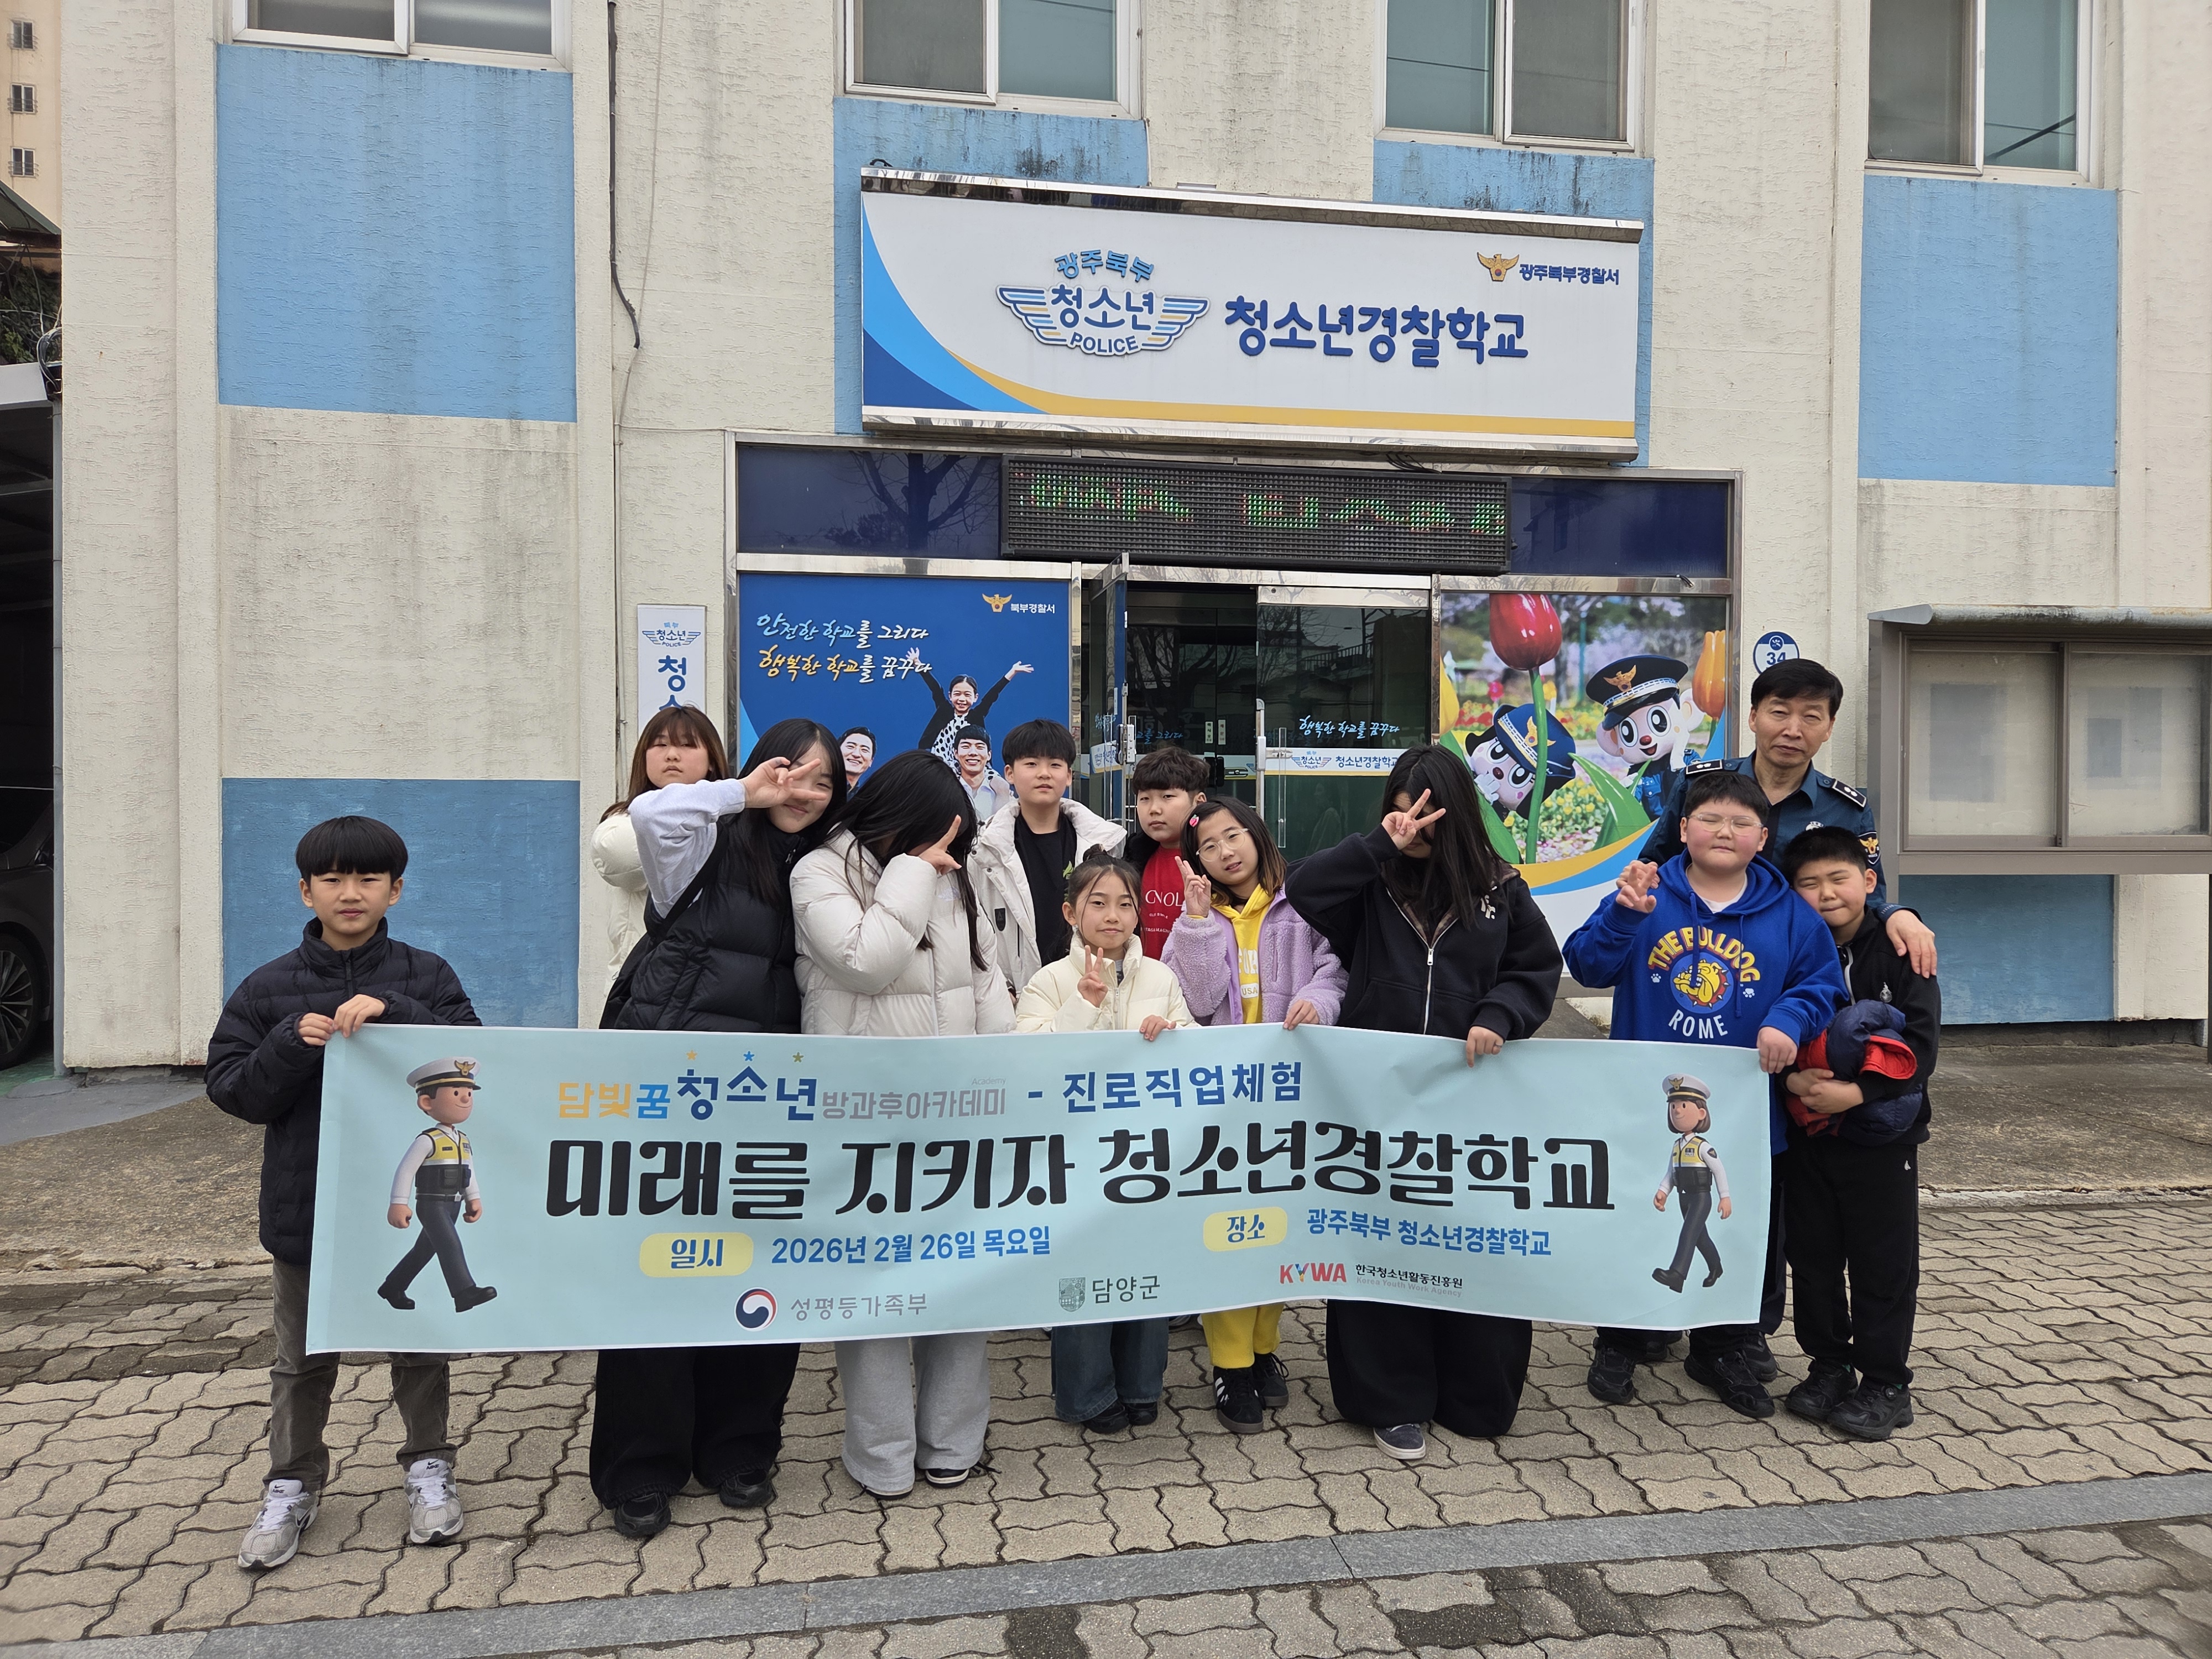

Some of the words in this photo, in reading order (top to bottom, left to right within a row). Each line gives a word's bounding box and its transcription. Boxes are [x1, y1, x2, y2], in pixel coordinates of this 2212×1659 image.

[1055, 249, 1155, 283] 광주북부
[1519, 264, 1620, 285] 광주북부경찰서
[1051, 284, 1154, 331] 청소년
[1070, 332, 1139, 353] POLICE
[1225, 295, 1529, 368] 청소년경찰학교
[1010, 603, 1055, 614] 북부경찰서
[656, 629, 686, 641] 청소년
[757, 612, 819, 641] 안전한
[822, 619, 873, 649] 학교를
[877, 624, 929, 640] 그리다
[759, 645, 822, 682] 행복한
[826, 654, 876, 684] 학교를
[881, 655, 933, 680] 꿈꾸다
[1300, 715, 1335, 738] 행복한
[1338, 721, 1366, 739] 학교를
[1370, 722, 1400, 737] 꿈꾸다
[1301, 755, 1322, 765] 청소년
[1648, 929, 1683, 971] THE
[1679, 926, 1761, 983] BULLDOG
[1241, 987, 1258, 995] USA
[1668, 1009, 1728, 1039] ROME
[971, 1077, 1006, 1085] Academy
[1062, 1062, 1301, 1113] 진로직업체험
[546, 1140, 810, 1219] 미래를
[835, 1134, 1075, 1215] 지키자
[1098, 1120, 1615, 1211] 청소년경찰학교
[1225, 1214, 1266, 1243] 장소
[1307, 1208, 1391, 1240] 광주북부
[1398, 1220, 1551, 1256] 청소년경찰학교
[670, 1239, 723, 1269] 일시
[771, 1235, 867, 1264] 2026년
[874, 1234, 912, 1263] 2월
[921, 1230, 977, 1260] 26일
[982, 1226, 1051, 1257] 목요일
[1280, 1262, 1347, 1285] KYWA
[1355, 1264, 1463, 1289] 한국청소년활동진흥원
[1357, 1276, 1380, 1285] Korea
[1383, 1279, 1406, 1289] Youth
[1408, 1283, 1429, 1293] Work
[1431, 1286, 1462, 1298] Agency
[1093, 1275, 1160, 1304] 담양군
[790, 1293, 927, 1321] 성평등가족부
